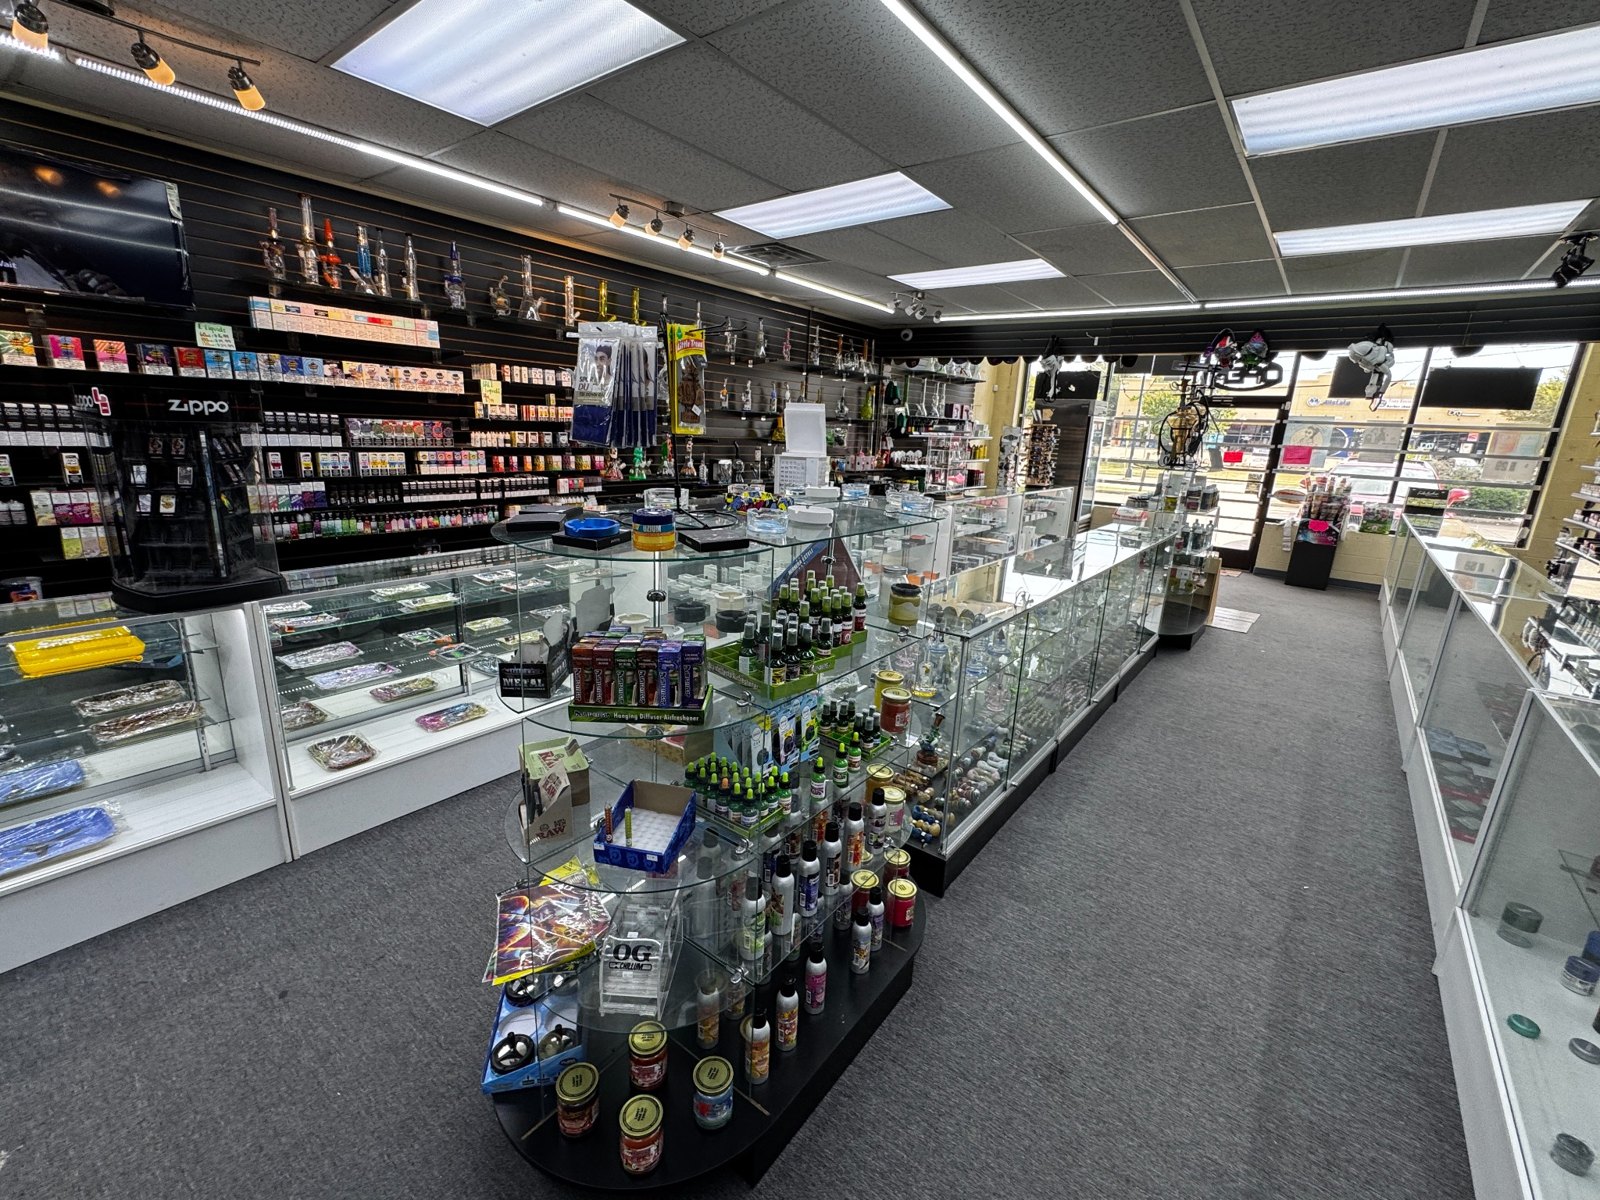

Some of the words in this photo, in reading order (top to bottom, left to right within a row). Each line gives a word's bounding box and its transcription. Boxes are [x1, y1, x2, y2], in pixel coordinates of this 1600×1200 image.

[502, 677, 544, 687] METAL
[613, 712, 638, 721] Hanging
[613, 943, 652, 962] OG
